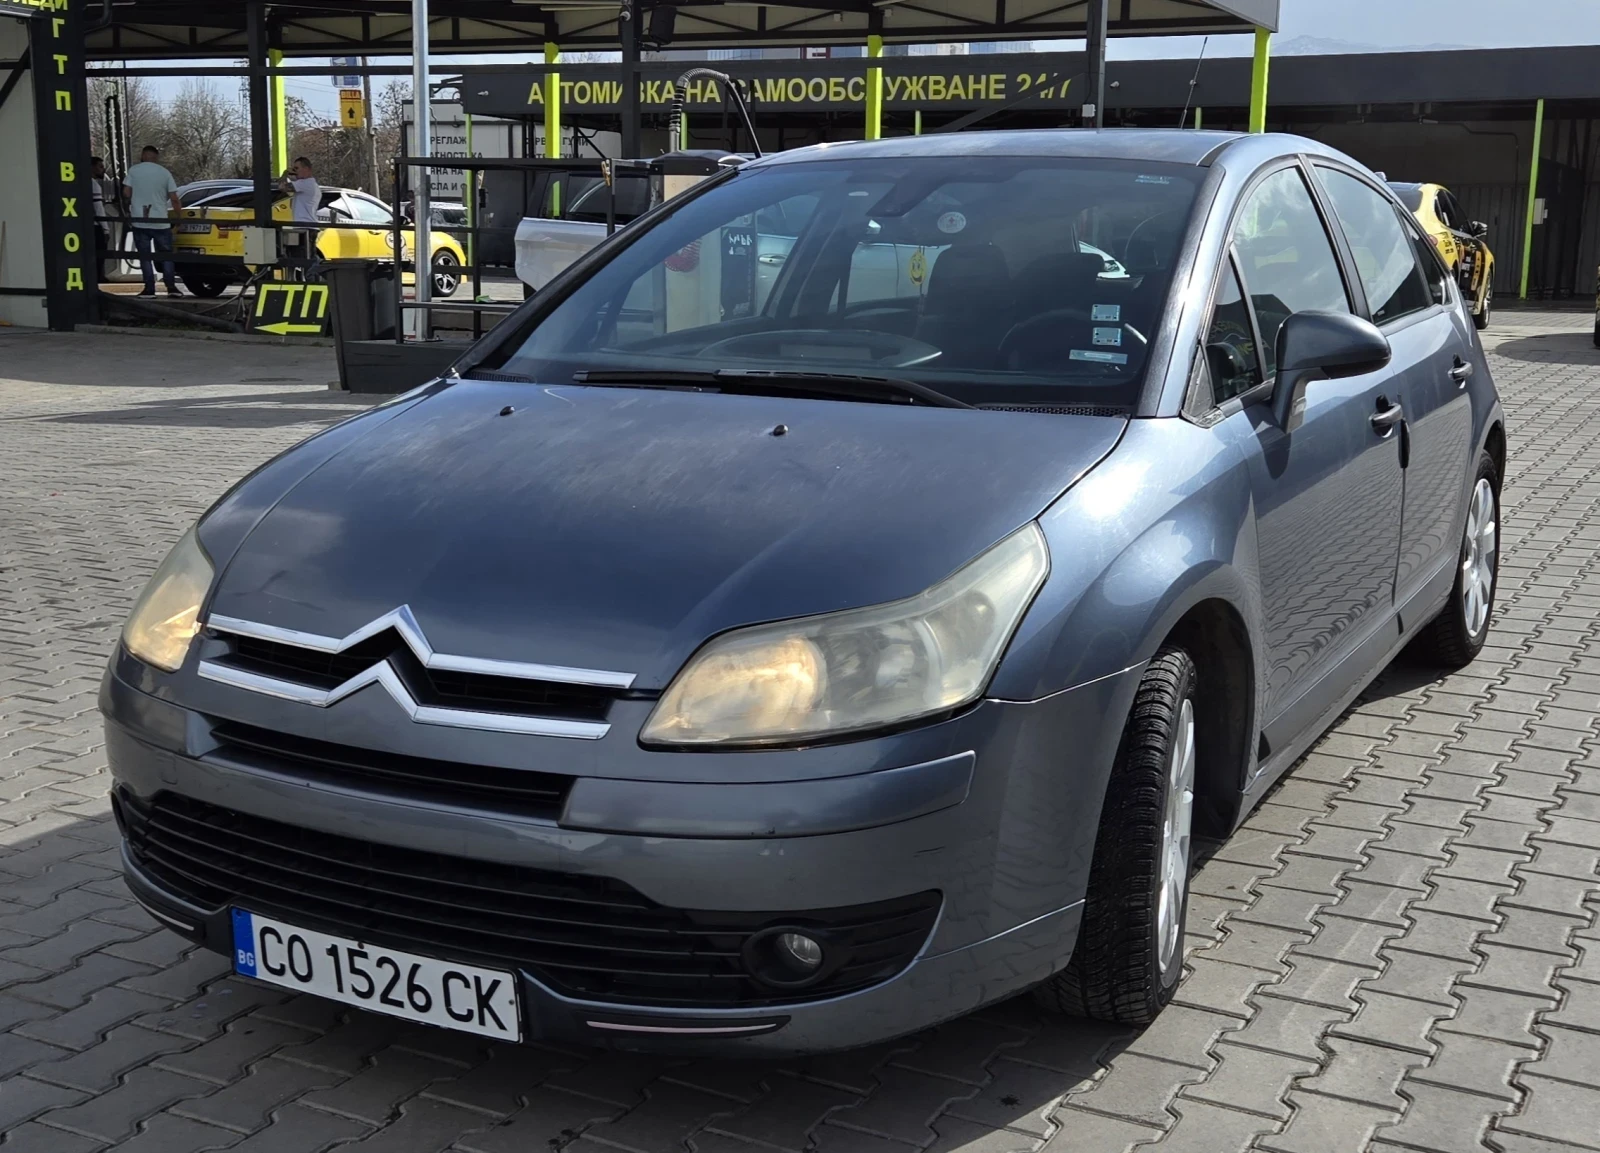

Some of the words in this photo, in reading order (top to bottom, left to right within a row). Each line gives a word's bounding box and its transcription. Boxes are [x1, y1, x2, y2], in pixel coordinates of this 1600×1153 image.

[52, 18, 72, 111] ГТП
[686, 79, 721, 103] НА
[729, 74, 1006, 103] САМООБСУЖВАНЕ
[60, 161, 83, 291] ВХОД
[255, 284, 328, 318] ГТП
[238, 949, 255, 967] BG
[259, 925, 313, 983] CO
[326, 944, 432, 1013] 1526
[442, 970, 507, 1031] CK
